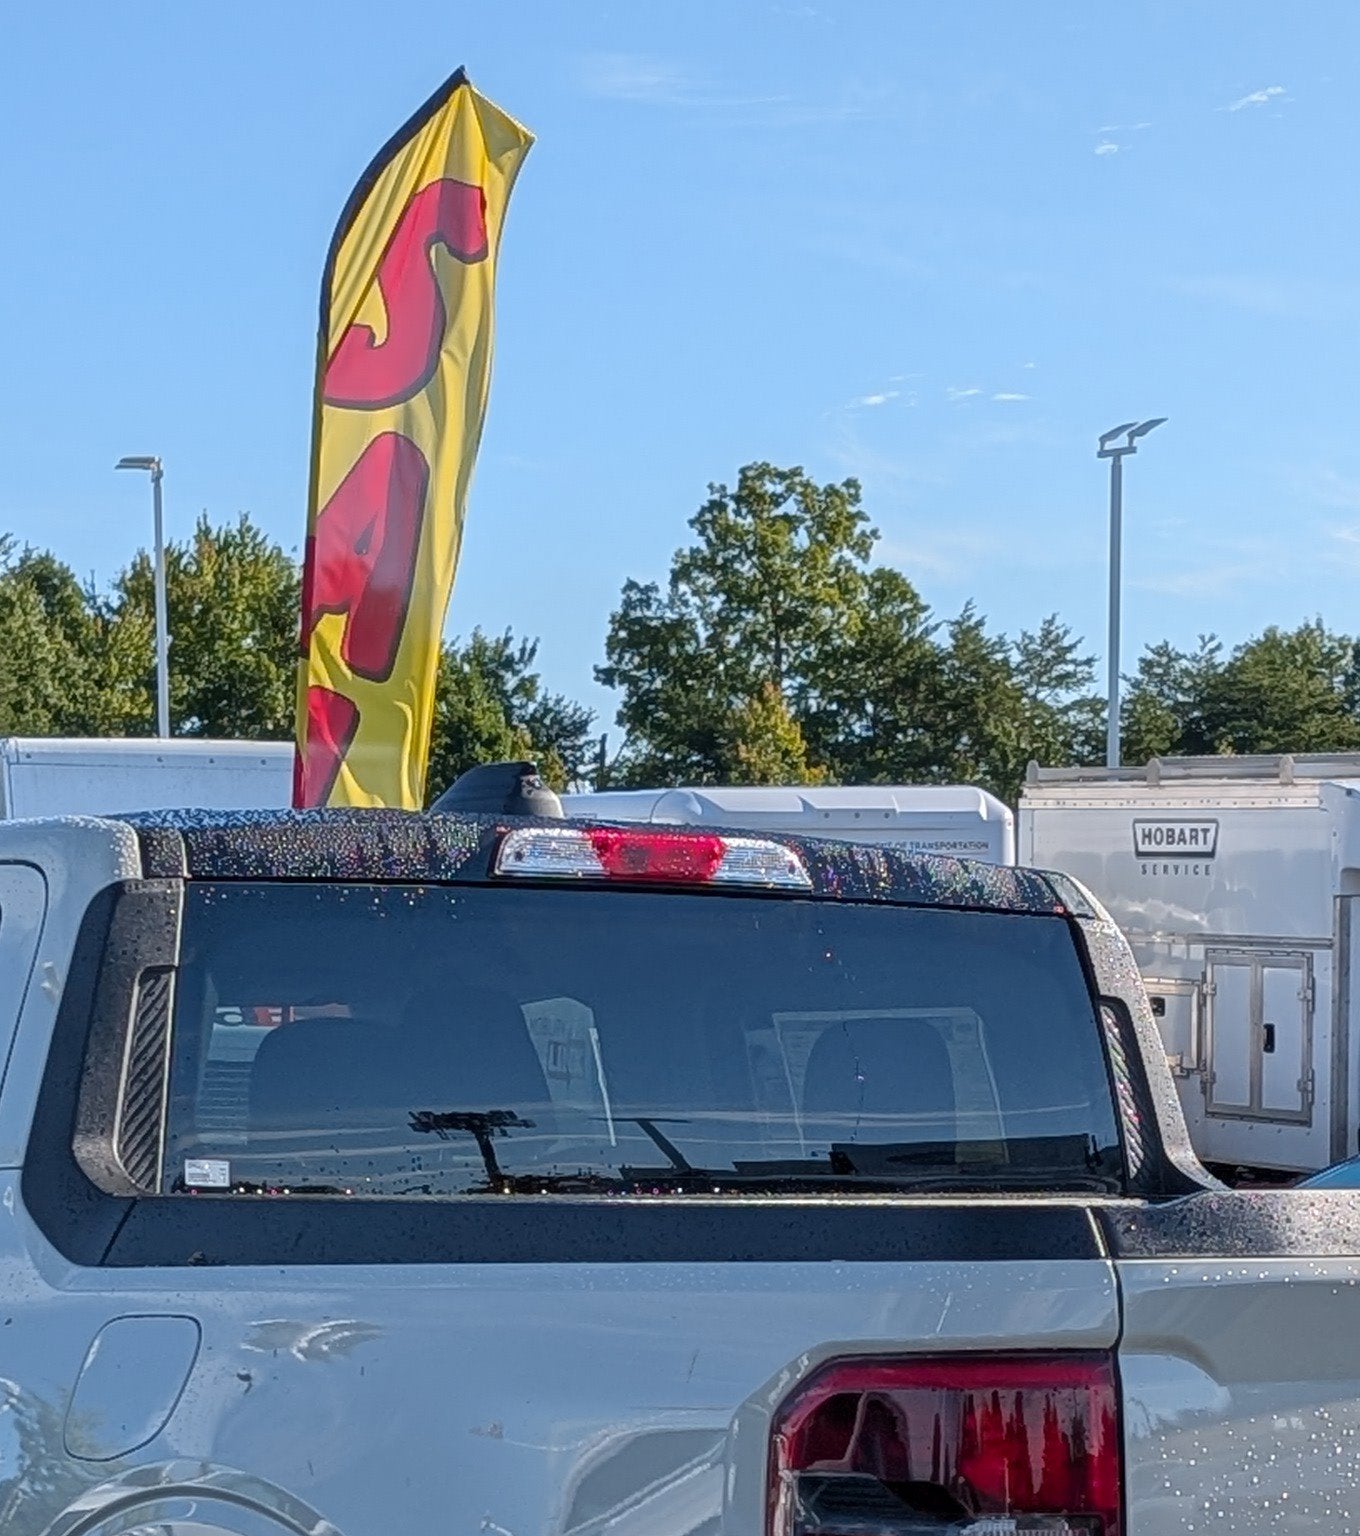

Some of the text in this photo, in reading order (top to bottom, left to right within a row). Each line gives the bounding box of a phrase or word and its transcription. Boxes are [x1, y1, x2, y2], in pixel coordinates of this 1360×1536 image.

[1141, 827, 1211, 846] HOBART
[910, 841, 989, 851] TRANSPORTATION
[1141, 864, 1211, 876] SERVICE
